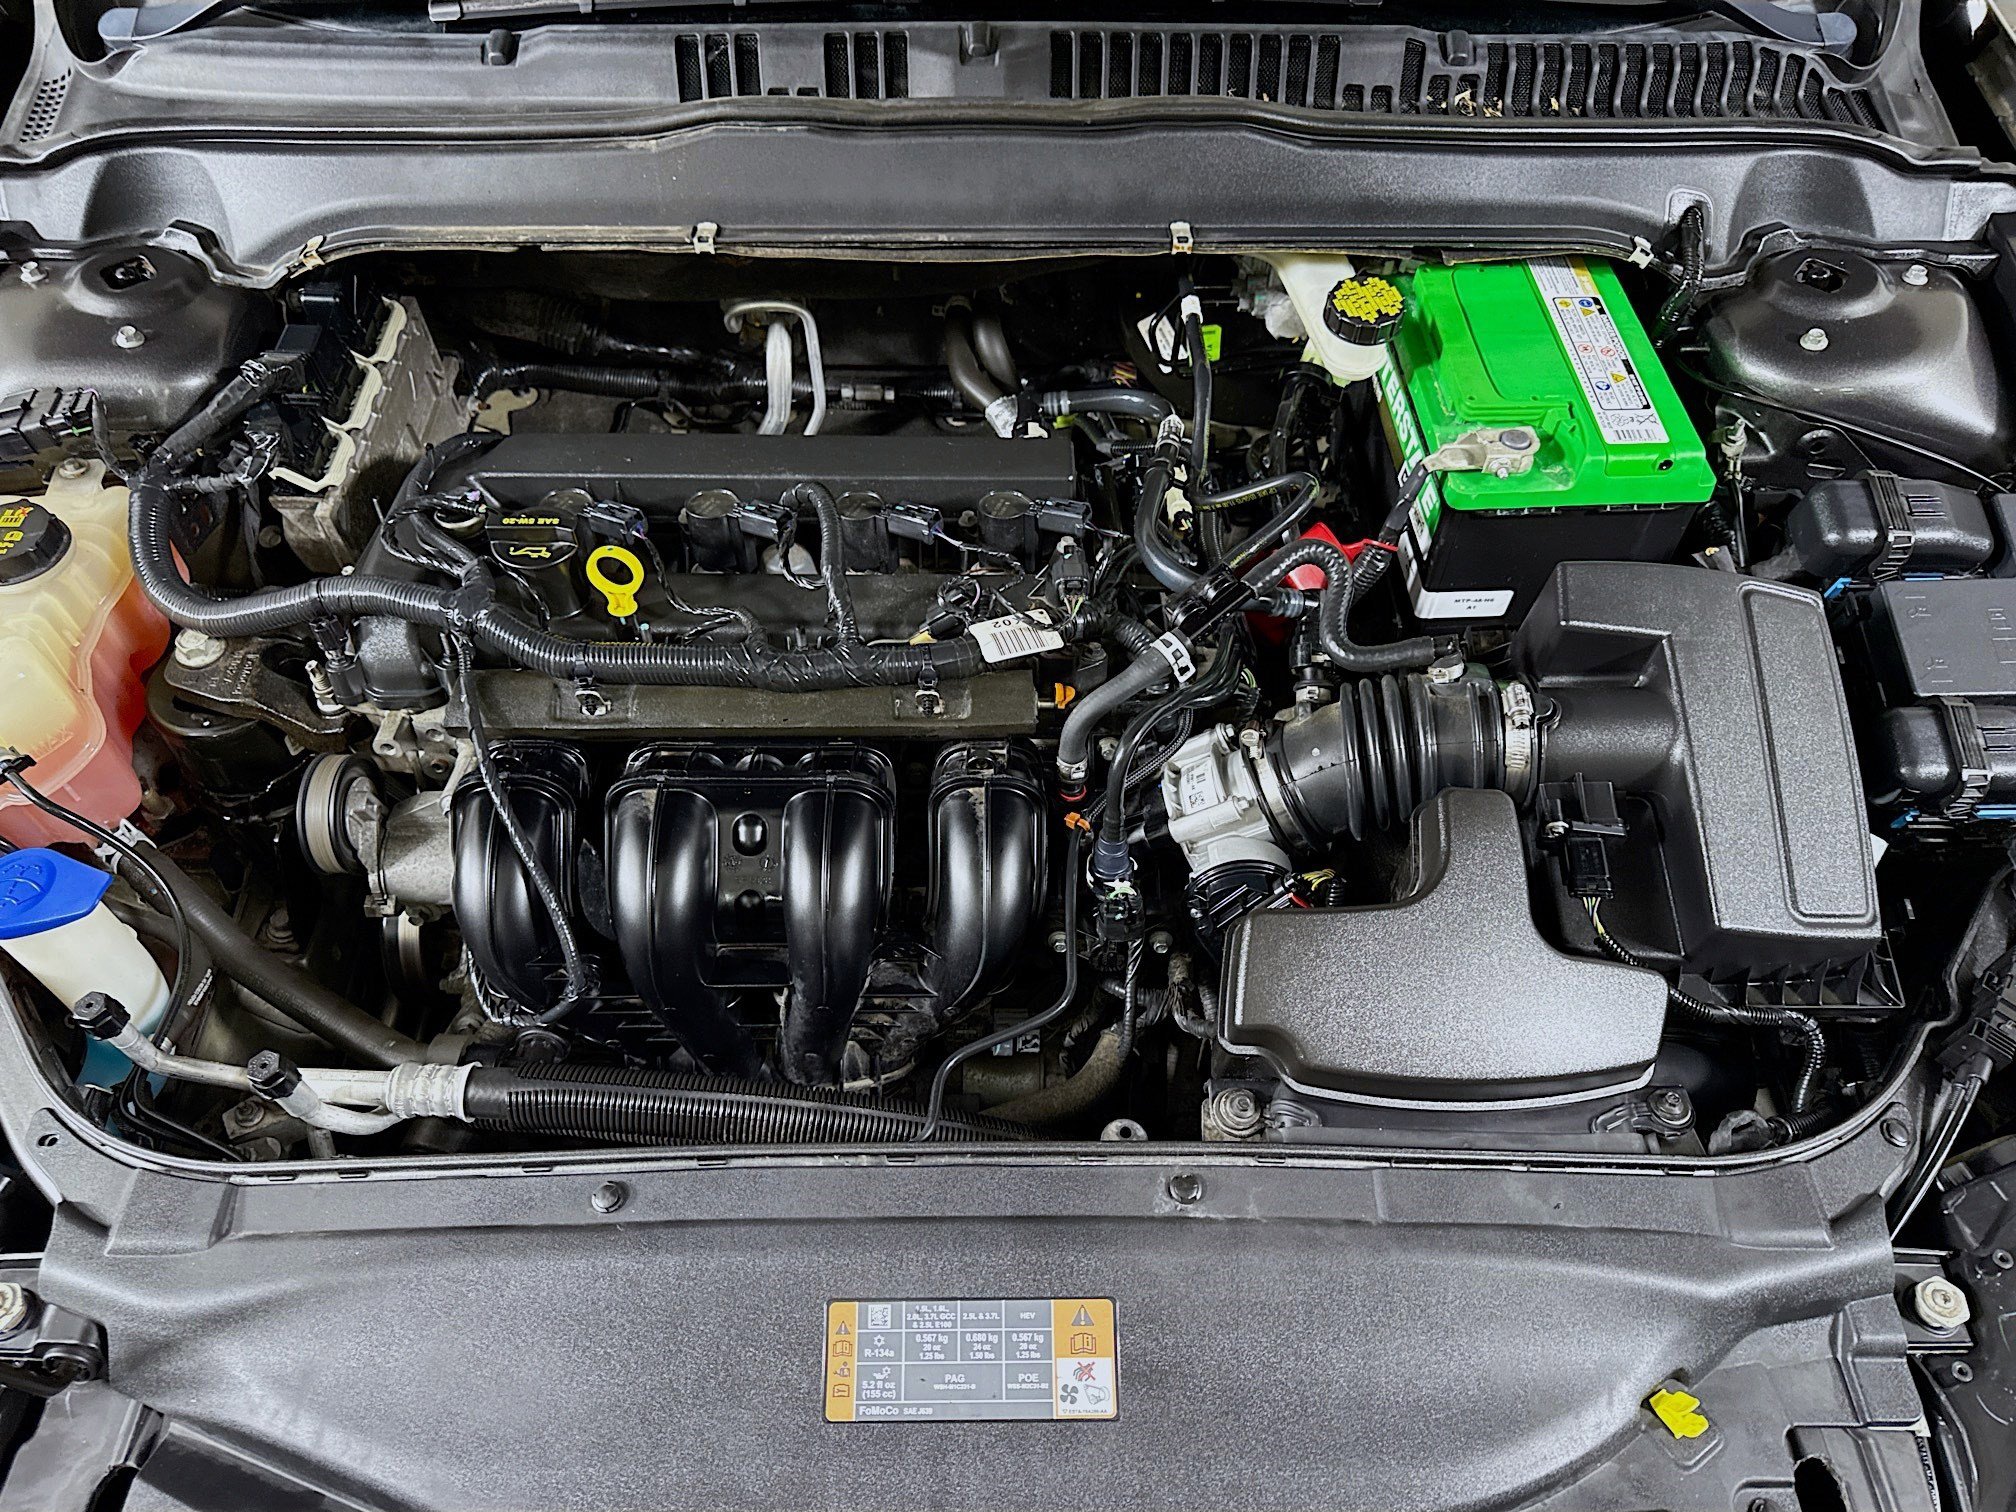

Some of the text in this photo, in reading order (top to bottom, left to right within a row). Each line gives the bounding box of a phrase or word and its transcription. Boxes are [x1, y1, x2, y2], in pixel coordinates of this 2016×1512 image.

[502, 517, 560, 525] SAE 5W-20
[1020, 1312, 1036, 1320] HEV
[916, 1334, 949, 1344] 0.567 kg
[965, 1333, 998, 1344] 0.680 kg
[1012, 1333, 1044, 1343] 0.567 kg
[864, 1348, 895, 1358] R-134a
[919, 1352, 945, 1360] 1.25 lbs
[969, 1352, 983, 1360] 1.50
[1015, 1351, 1041, 1359] 1.25 lbs
[944, 1374, 966, 1383] PAG
[1018, 1373, 1039, 1382] POE
[862, 1381, 875, 1389] 5.2
[876, 1381, 883, 1389] fl
[862, 1390, 896, 1400] (155 cc)
[859, 1406, 899, 1415] FoMoCo
[903, 1407, 917, 1415] SAE
